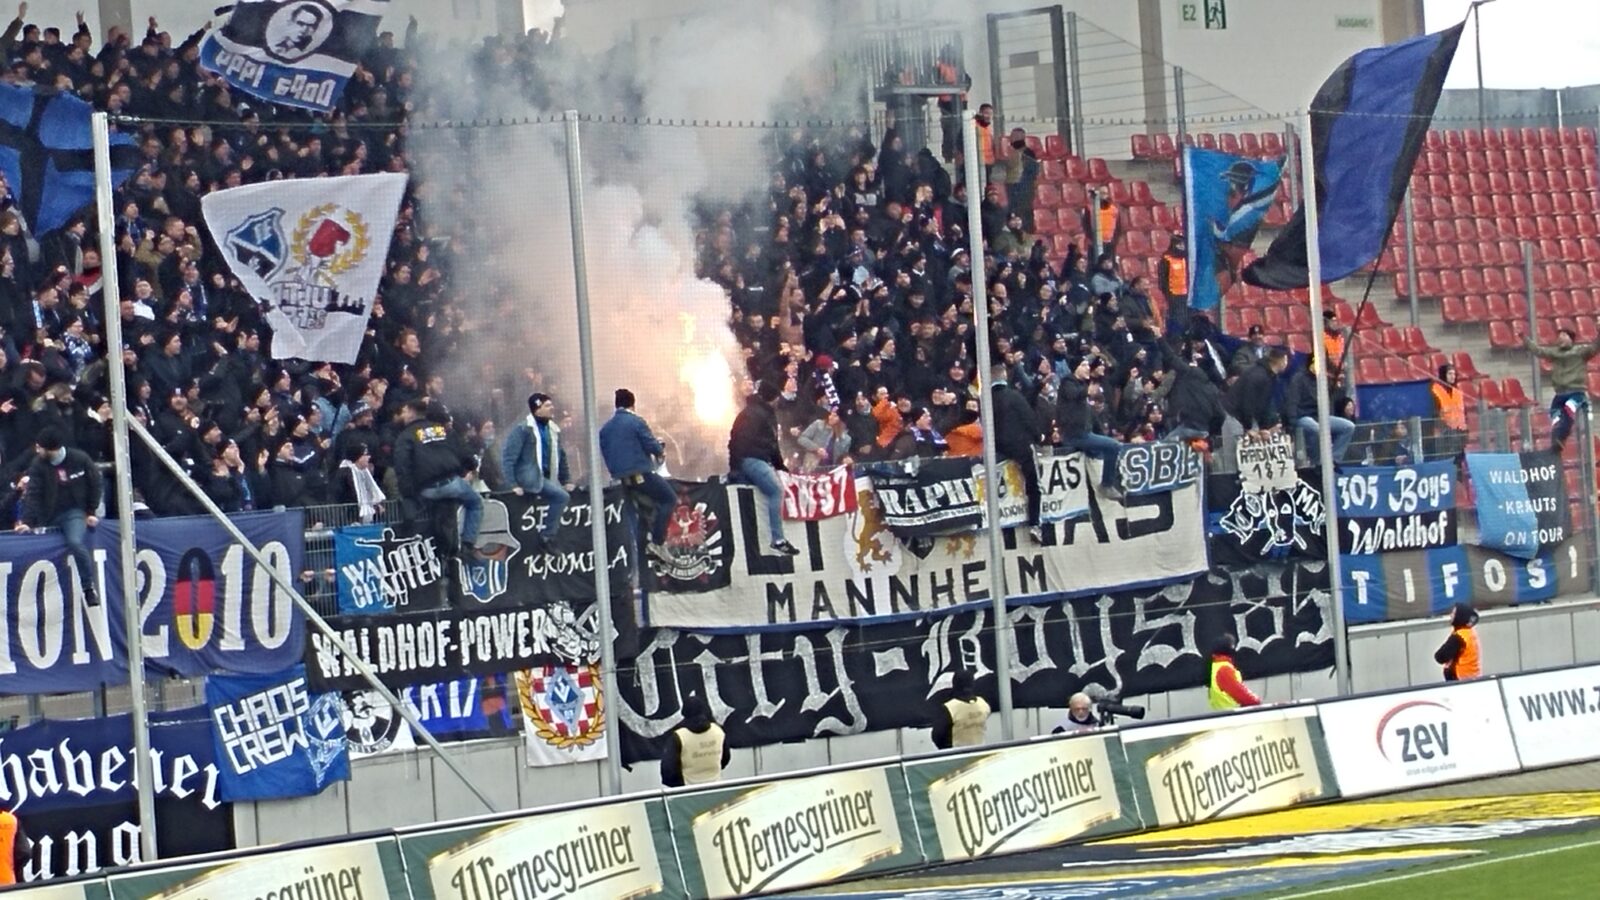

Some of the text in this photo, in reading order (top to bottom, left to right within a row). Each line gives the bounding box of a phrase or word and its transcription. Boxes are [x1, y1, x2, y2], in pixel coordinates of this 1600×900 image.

[1182, 4, 1197, 21] E2
[1240, 445, 1293, 464] RADIKAL
[1253, 460, 1288, 480] 187
[1489, 464, 1557, 485] WALDHOF
[1388, 468, 1450, 513] Boys
[1498, 497, 1557, 515] -KRAUTS
[521, 499, 624, 533] SECTIN
[1348, 511, 1449, 555] Waldhof
[1504, 526, 1564, 546] ON TOUR
[136, 541, 292, 659] 2010
[766, 554, 1048, 624] MANNHEM
[312, 608, 551, 678] WALDHOF-POWER
[214, 678, 310, 741] CHAOS
[225, 716, 310, 775] CREW
[1395, 721, 1450, 763] zev
[1162, 734, 1300, 824] Wernesgrüner
[946, 757, 1096, 857] Wernesgrüner
[712, 789, 877, 895] Wernesgrüner
